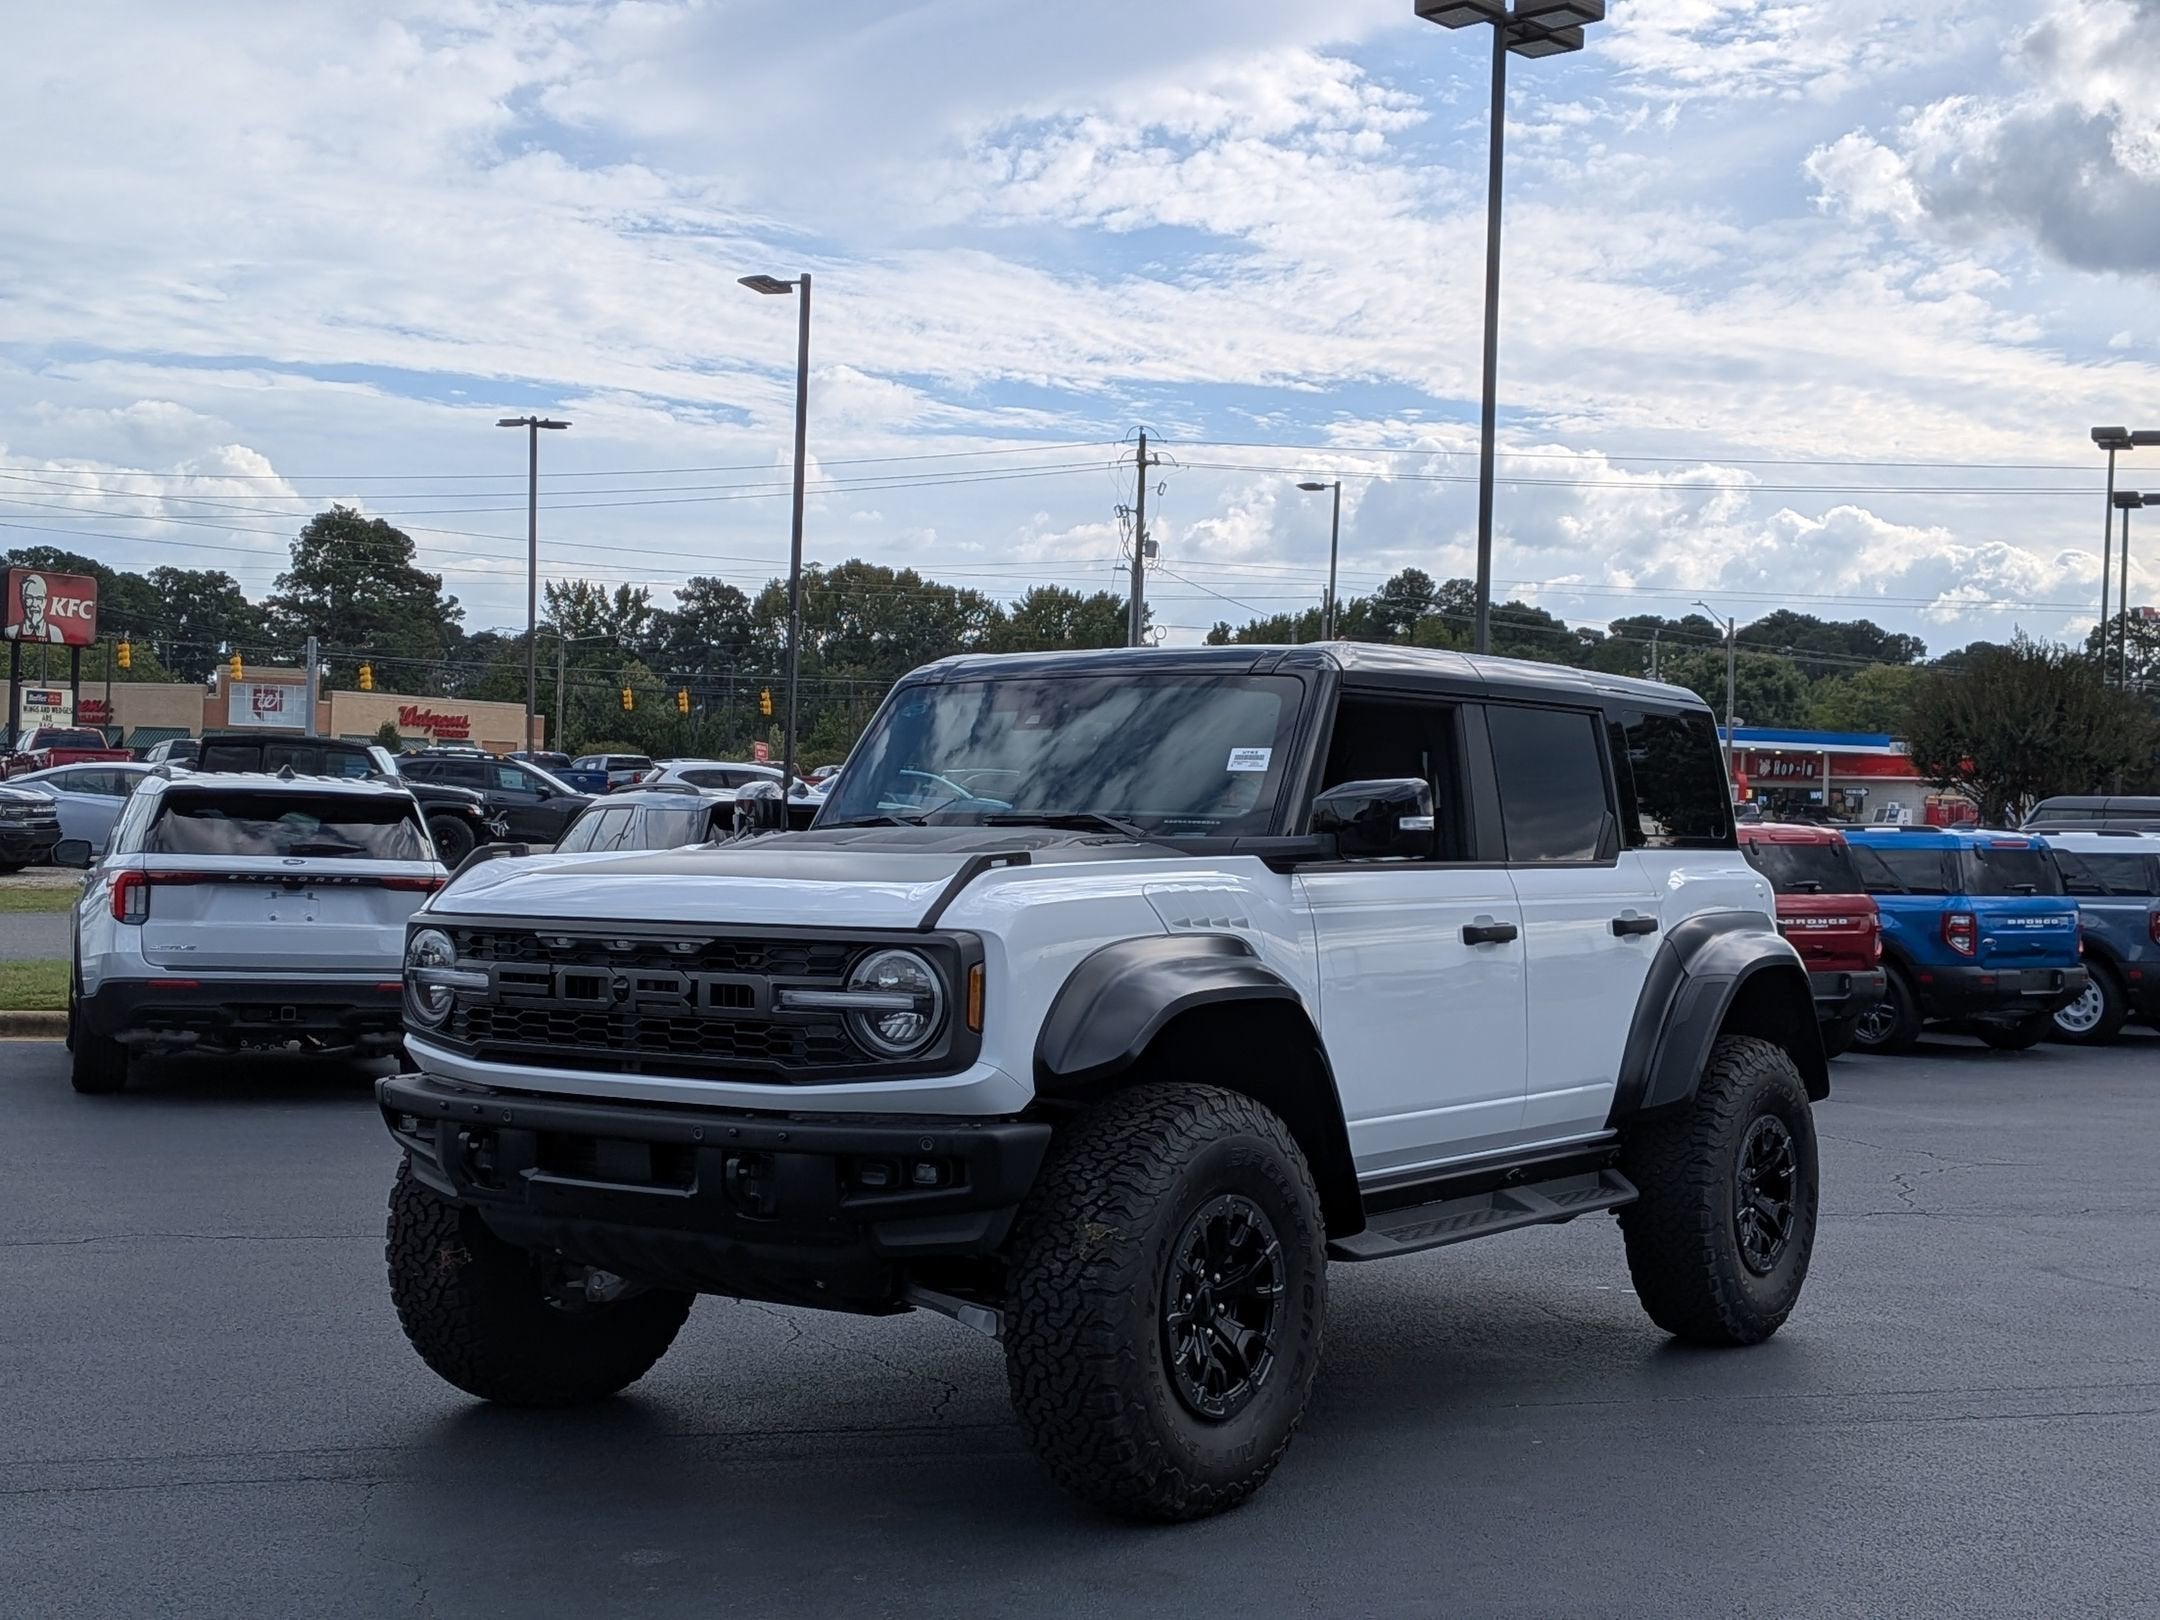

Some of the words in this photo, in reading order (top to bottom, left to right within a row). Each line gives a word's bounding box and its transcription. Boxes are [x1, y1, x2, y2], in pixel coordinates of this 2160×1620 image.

[50, 596, 94, 620] KFC
[228, 875, 359, 883] EXPLORER
[490, 961, 769, 1018] FORD
